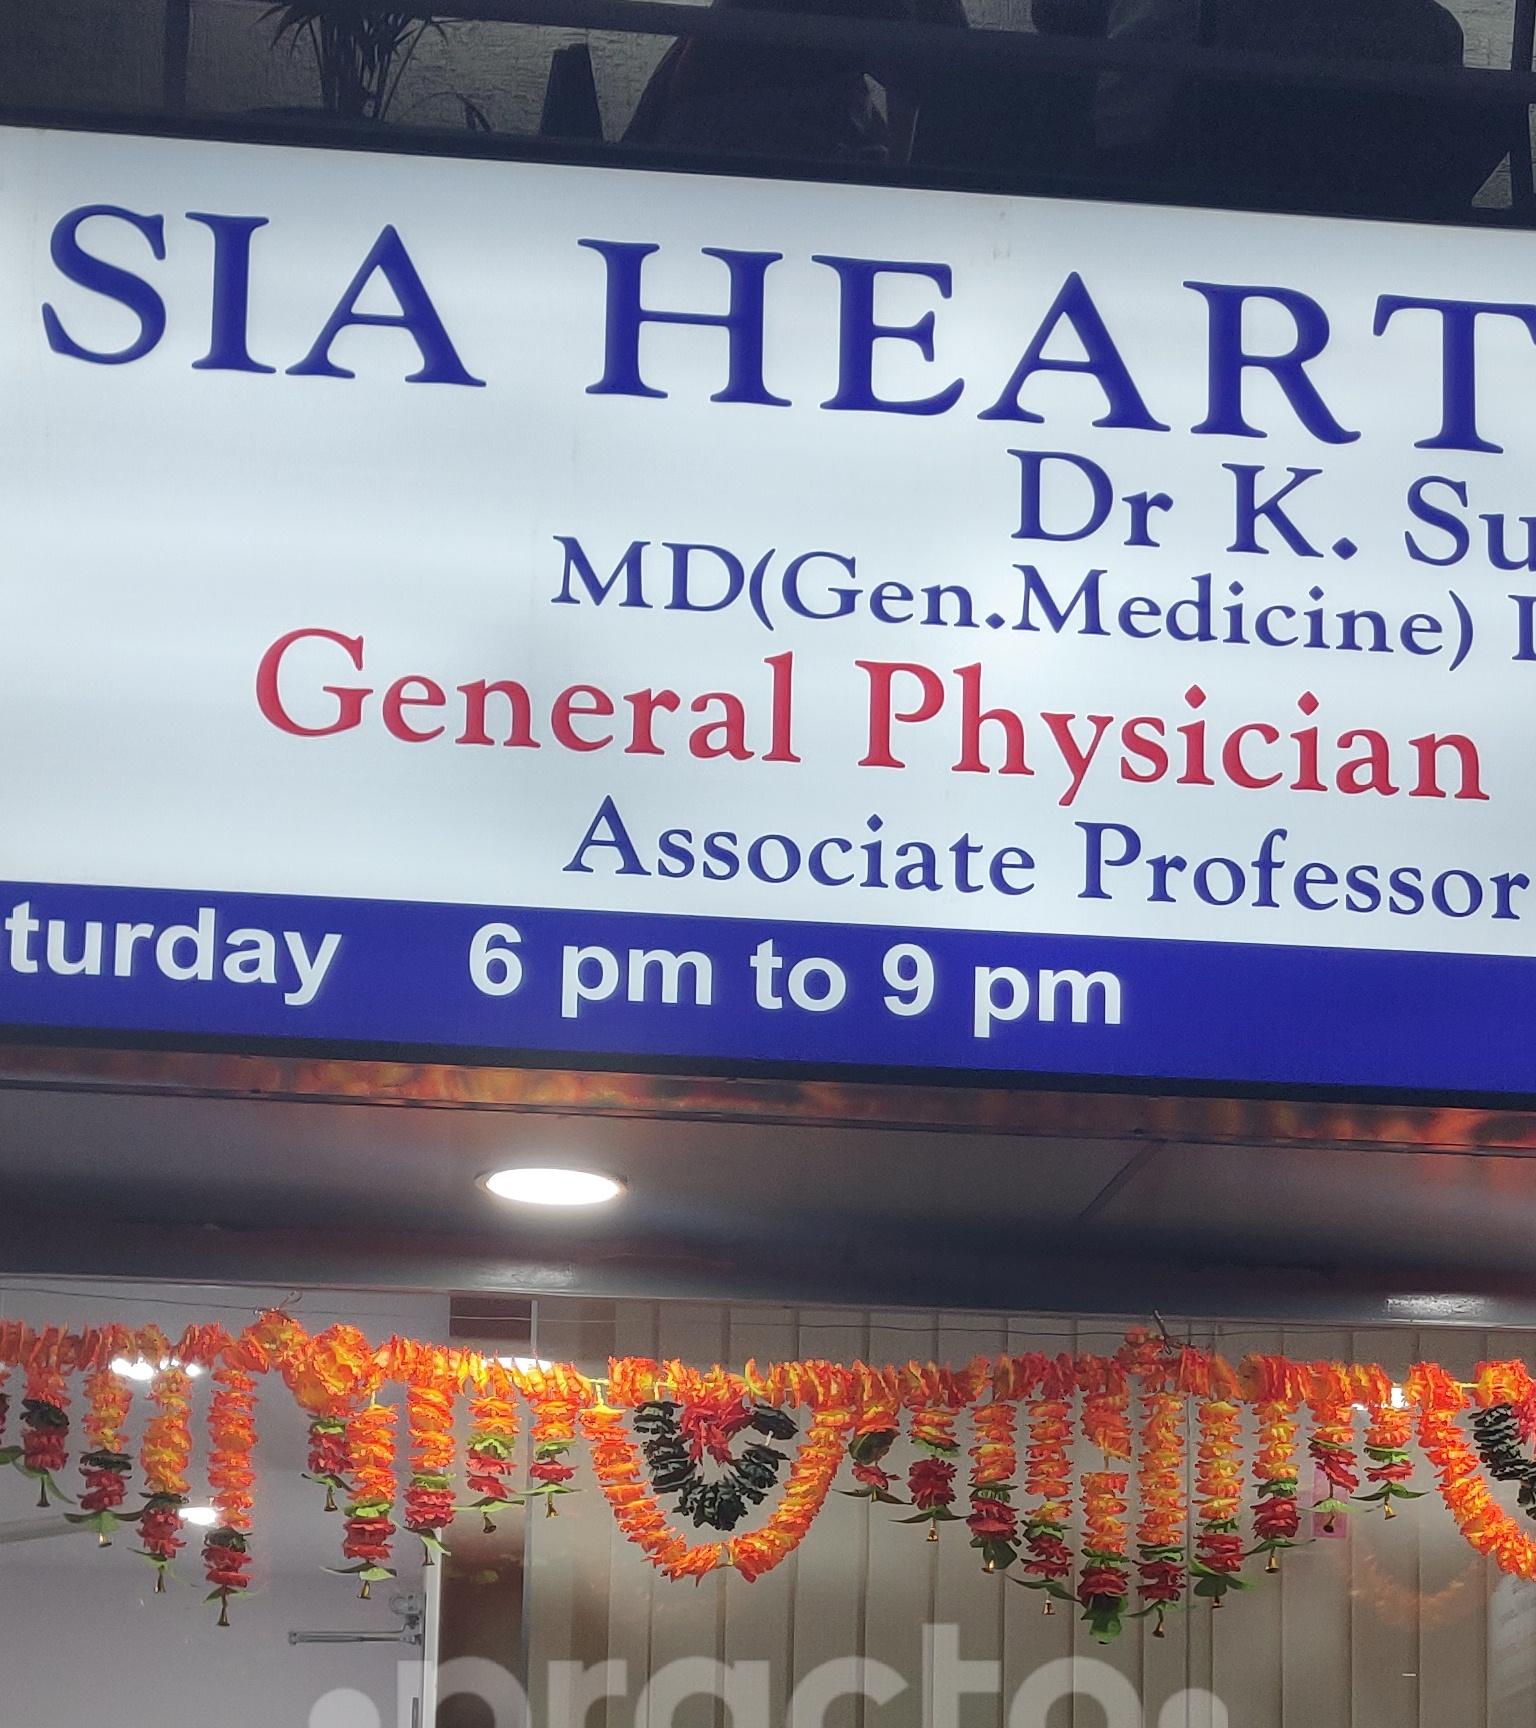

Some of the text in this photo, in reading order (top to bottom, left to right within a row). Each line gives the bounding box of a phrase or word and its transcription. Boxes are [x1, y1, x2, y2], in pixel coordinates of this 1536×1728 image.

[40, 203, 488, 389] SIA
[1005, 447, 1175, 549] Dr
[1220, 462, 1359, 562] K.
[549, 534, 1475, 673] MD(Gen.Medicine)
[255, 627, 803, 764] General
[853, 659, 1491, 808] Physician
[561, 793, 1036, 897] Associate
[1073, 820, 1532, 921] Professor
[468, 921, 524, 997] 6
[560, 944, 714, 1020] pm
[748, 937, 848, 1013] to
[881, 942, 936, 1018] 9
[973, 965, 1122, 1039] pm
